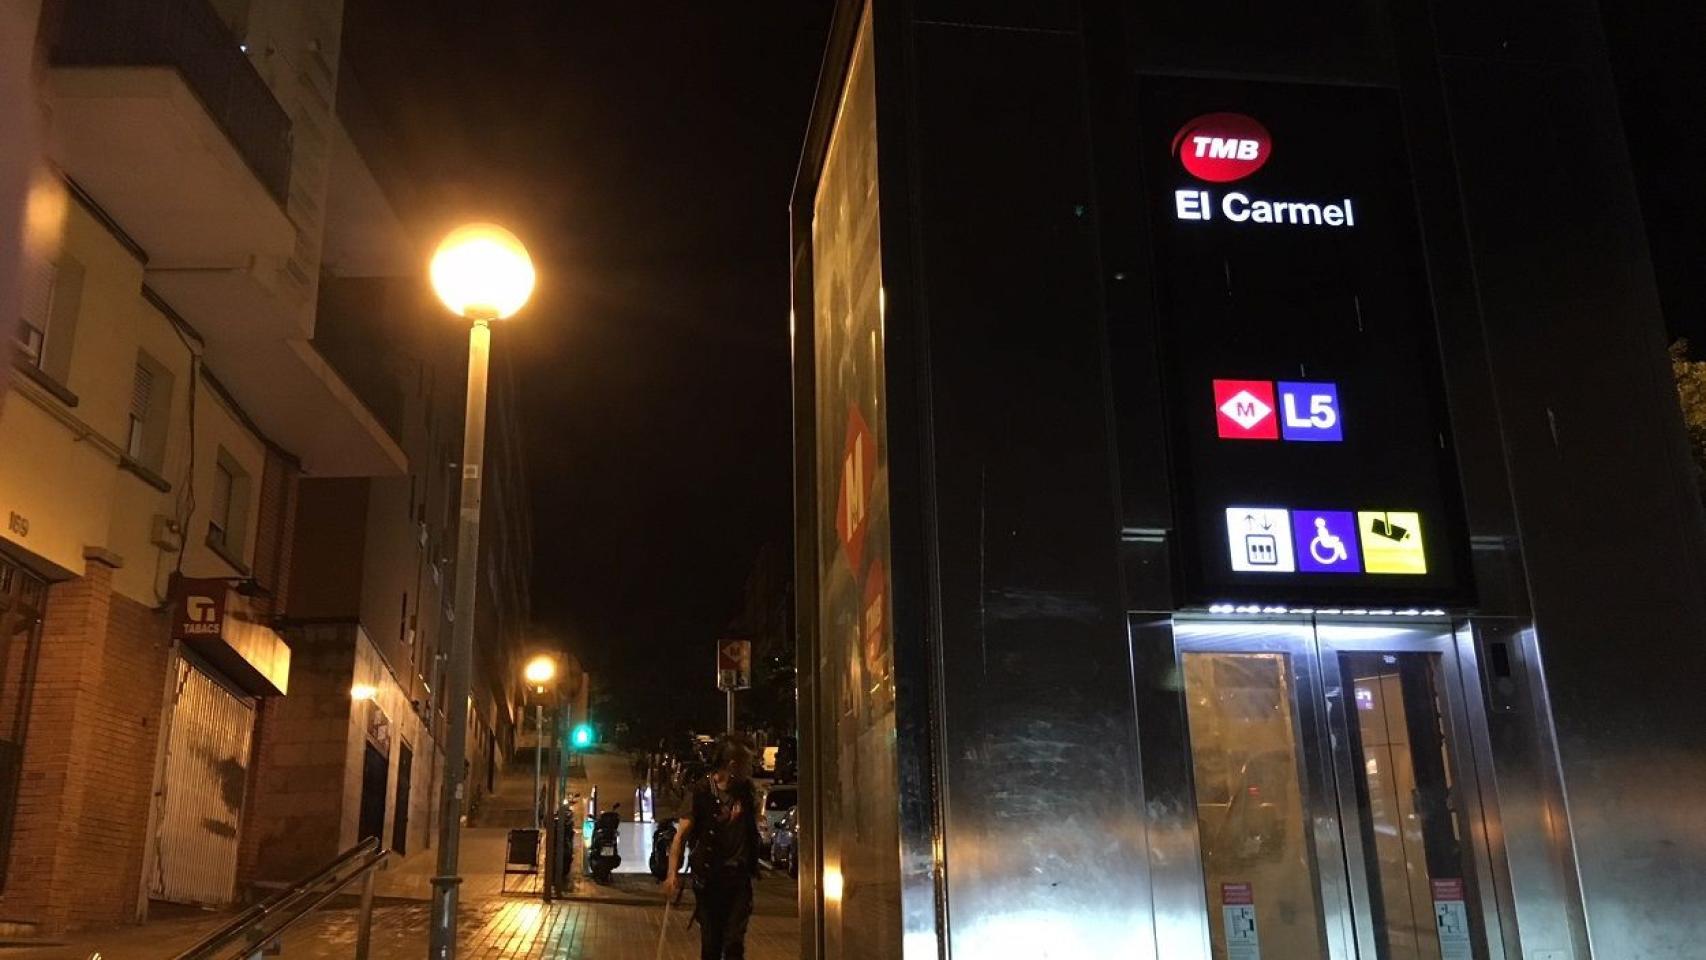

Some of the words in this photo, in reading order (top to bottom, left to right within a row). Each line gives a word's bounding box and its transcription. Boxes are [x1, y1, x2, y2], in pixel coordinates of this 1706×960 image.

[1193, 136, 1259, 160] TMB
[1175, 190, 1211, 220] El
[1222, 192, 1354, 226] Carmel
[1236, 402, 1255, 417] M
[1283, 393, 1336, 429] L5
[8, 510, 29, 537] 169
[183, 623, 220, 634] TABACS
